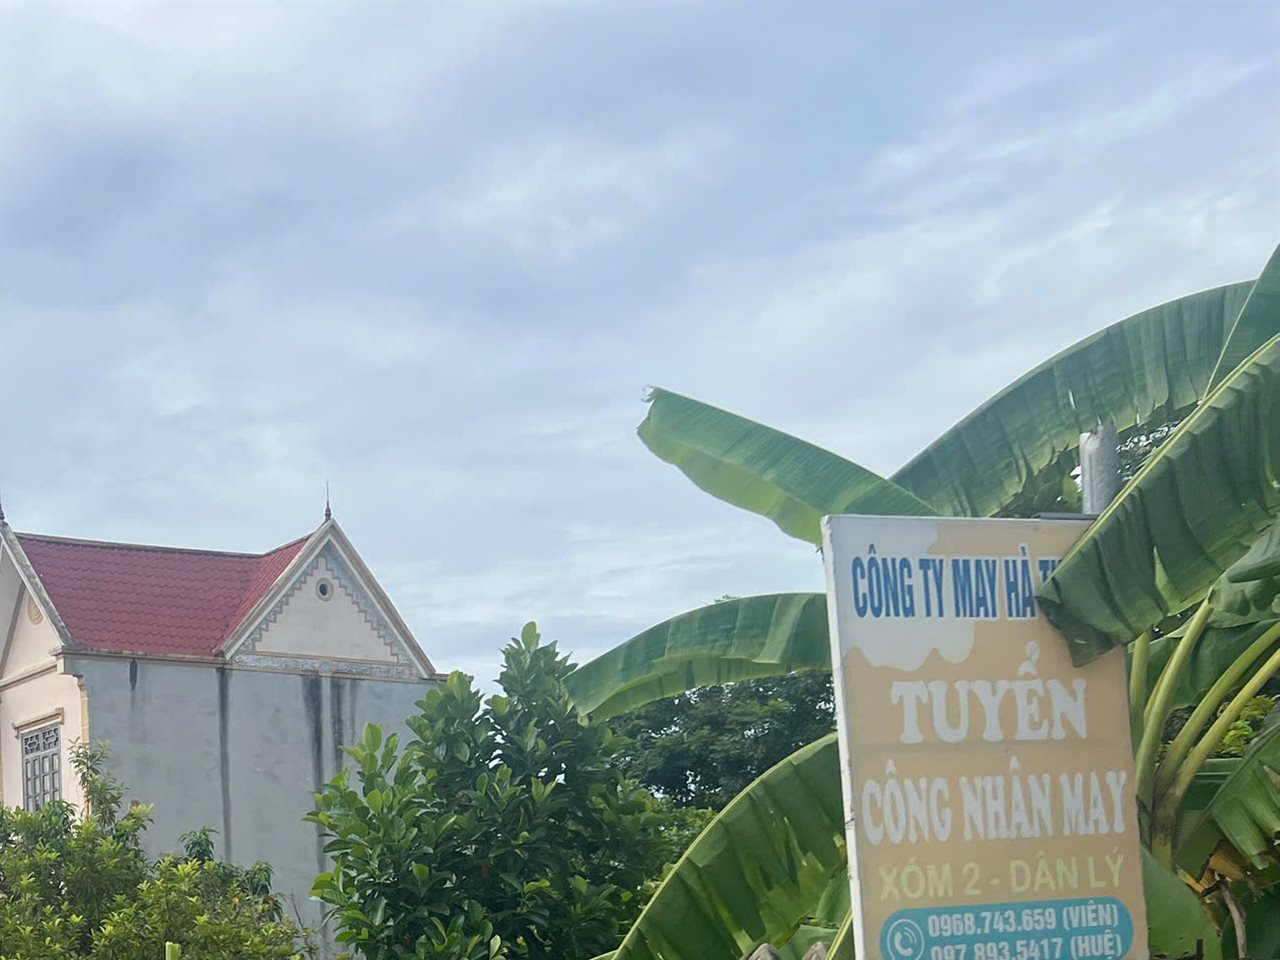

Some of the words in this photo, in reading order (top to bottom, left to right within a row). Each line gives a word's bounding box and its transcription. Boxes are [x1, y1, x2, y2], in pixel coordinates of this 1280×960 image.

[851, 544, 916, 618] CÔNG
[918, 558, 944, 618] TY
[951, 559, 997, 618] MAY
[1004, 546, 1036, 618] HÀ
[891, 641, 1088, 744] TUYỂN
[861, 759, 953, 846] CÔNG
[959, 755, 1053, 842] NHÂN
[1059, 770, 1128, 836] MAY
[878, 857, 954, 901] XÓM
[963, 862, 982, 896] 2
[990, 877, 1000, 886] -
[1009, 850, 1079, 894] DÂN
[1088, 847, 1125, 888] LÝ
[927, 907, 1057, 938] 0968.743.659
[1062, 900, 1120, 931] (VIÊN)
[1071, 929, 1123, 960] (HUỆ)
